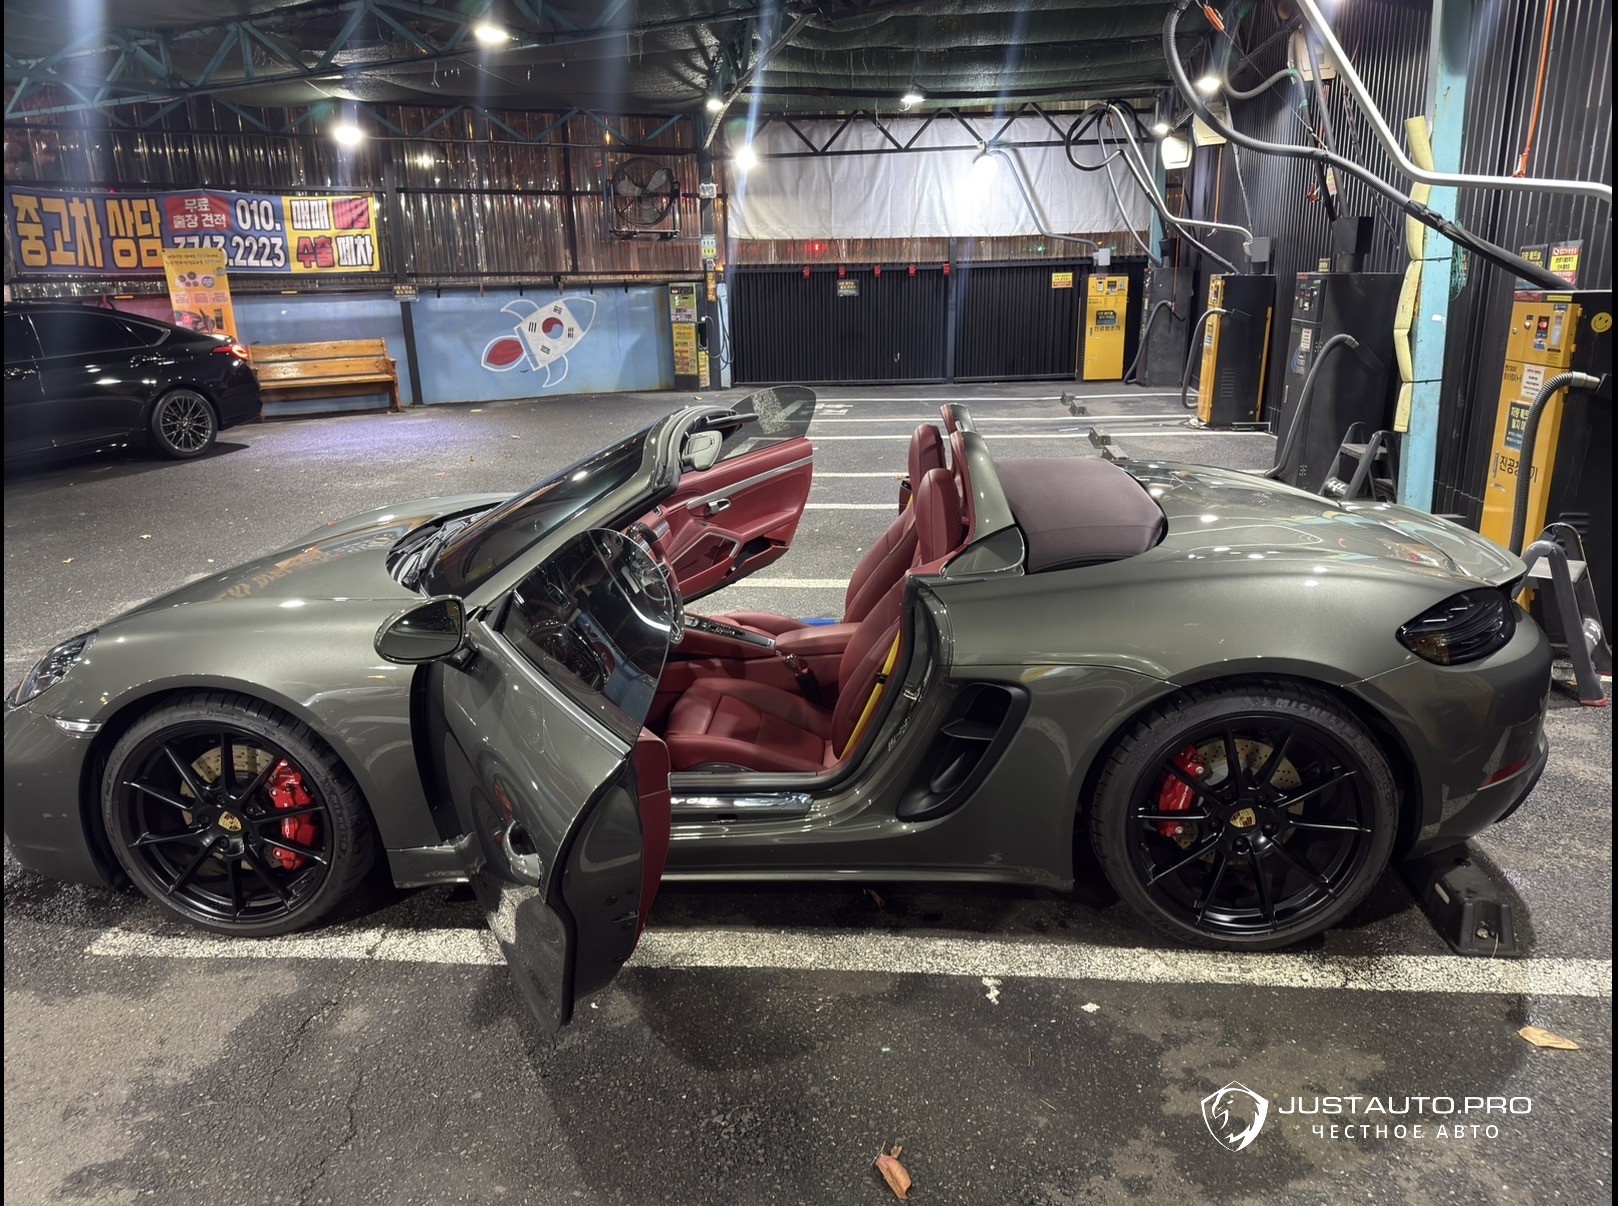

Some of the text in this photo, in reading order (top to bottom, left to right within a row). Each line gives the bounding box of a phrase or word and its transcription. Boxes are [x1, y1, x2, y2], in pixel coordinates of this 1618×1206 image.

[184, 197, 210, 212] 무료
[235, 199, 282, 231] 010.
[290, 199, 331, 230] 매매
[11, 194, 164, 268] 중고차 상담
[173, 213, 227, 229] 출장 견적
[297, 234, 374, 268] 수출 폐차
